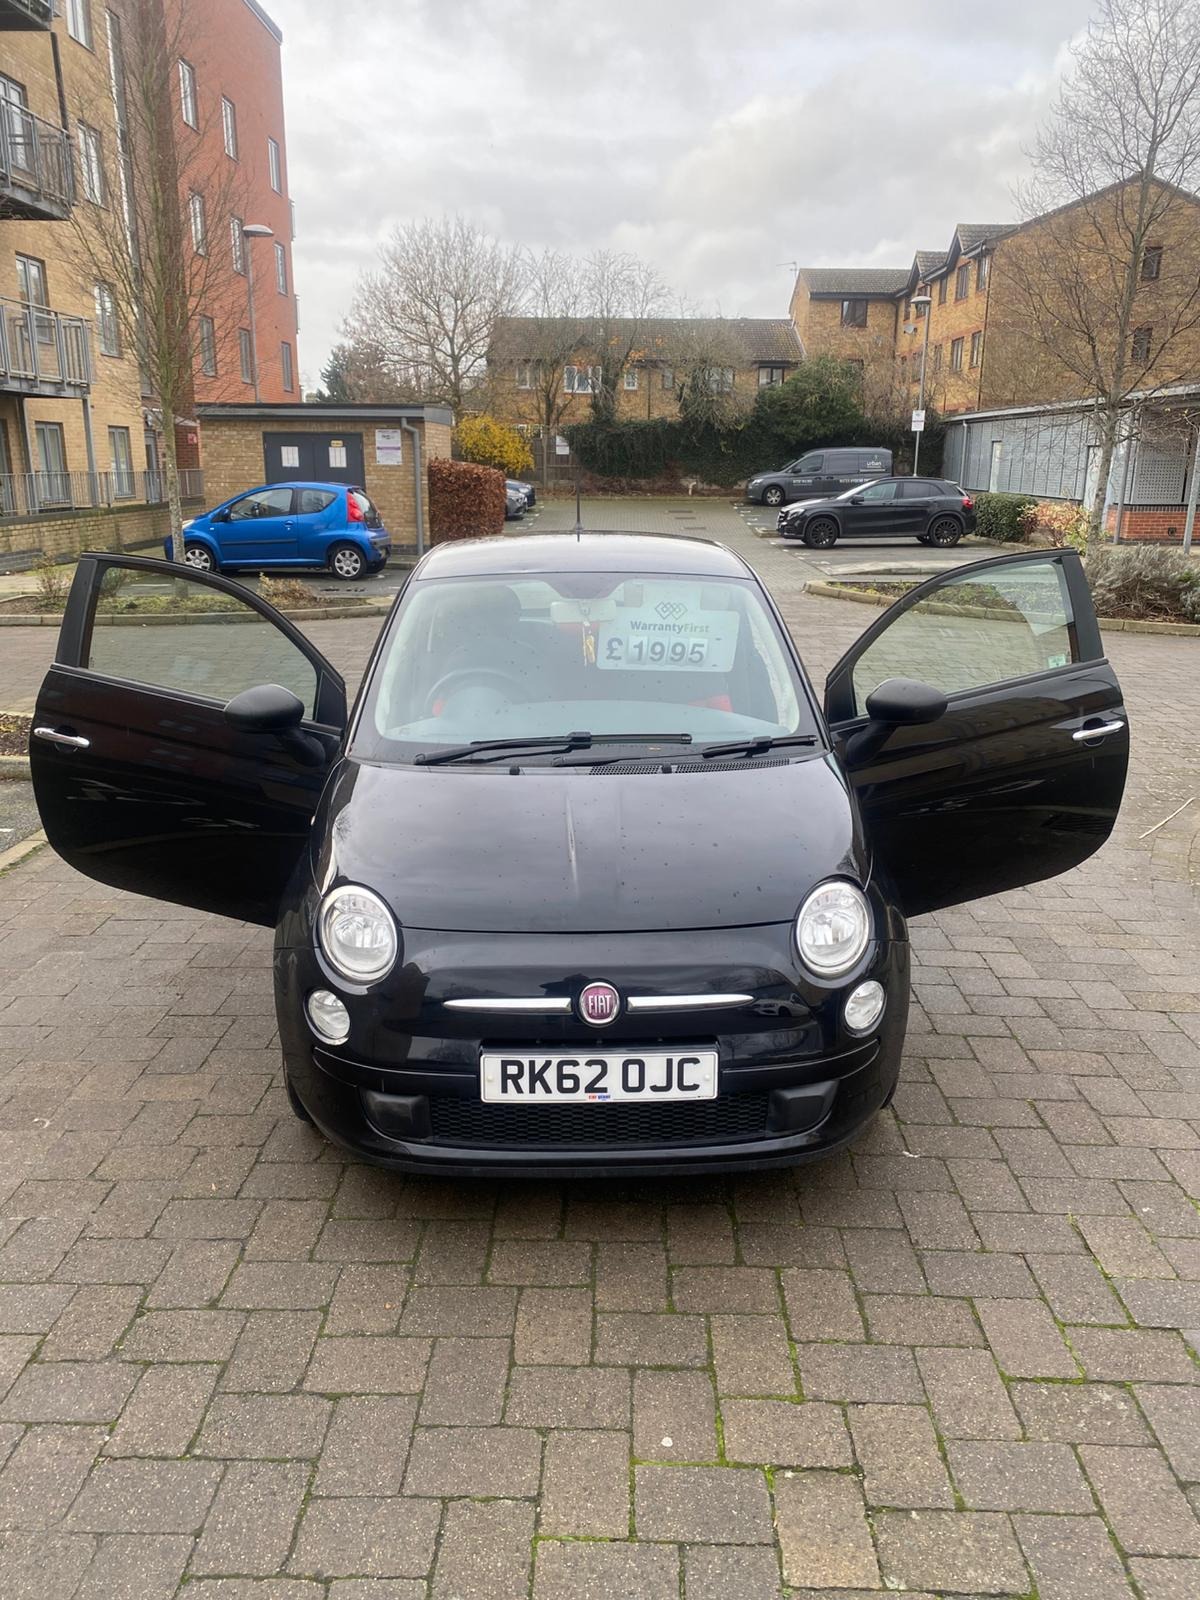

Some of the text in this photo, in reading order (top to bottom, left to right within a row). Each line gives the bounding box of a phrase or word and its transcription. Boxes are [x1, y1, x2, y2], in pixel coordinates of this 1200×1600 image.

[630, 620, 709, 634] WarrantyFirst
[588, 994, 612, 1015] FIAT
[500, 1057, 701, 1094] RK62 OJC
